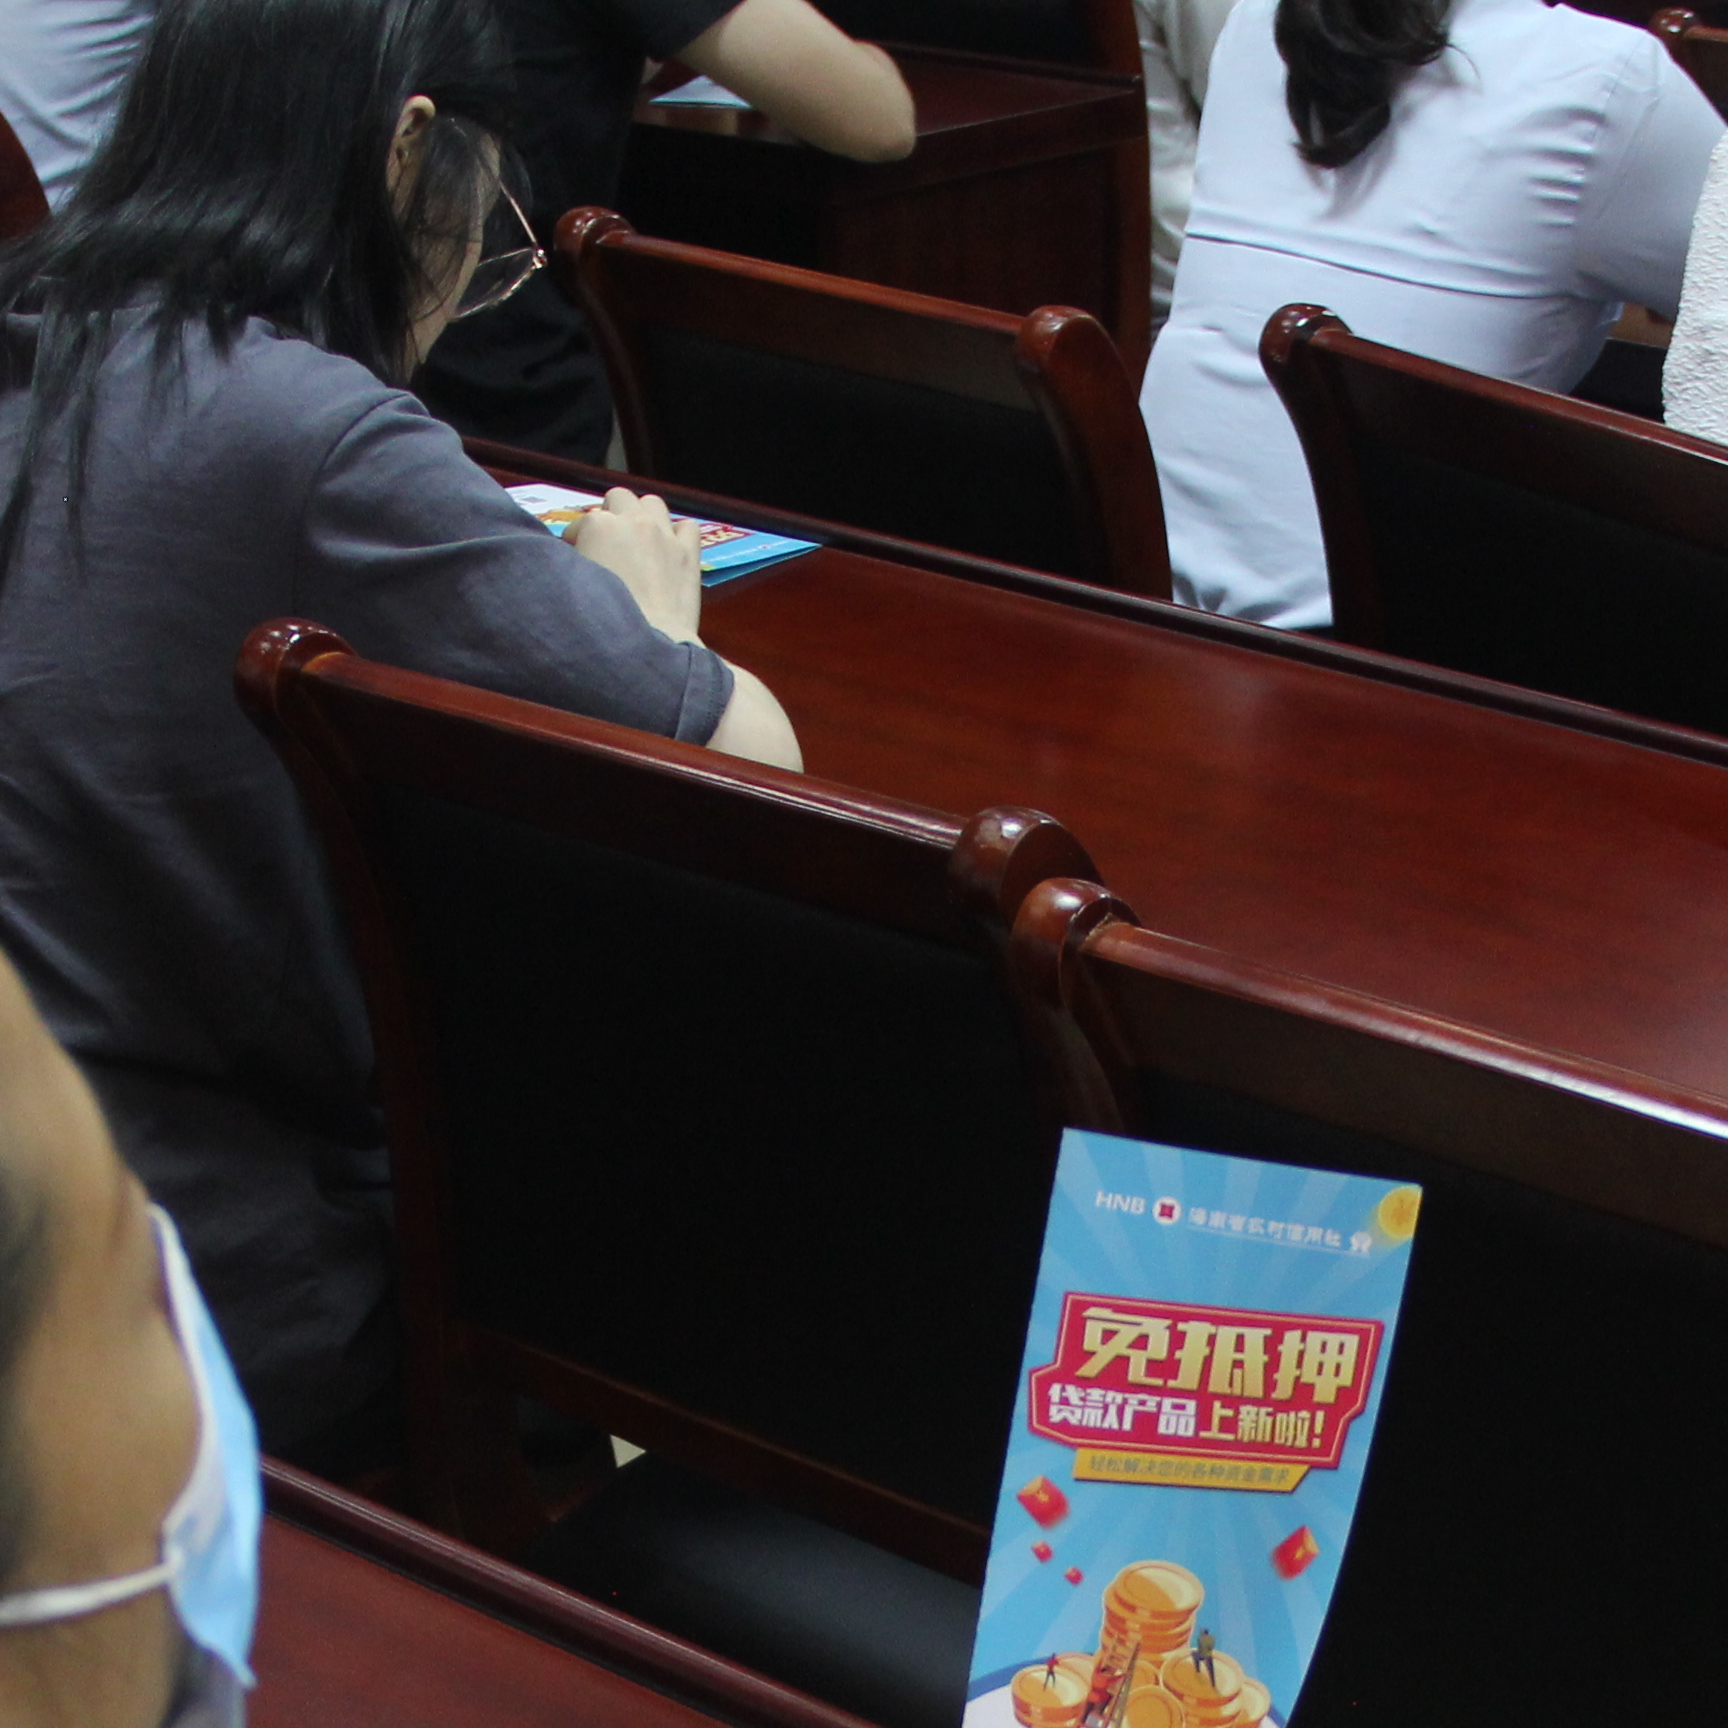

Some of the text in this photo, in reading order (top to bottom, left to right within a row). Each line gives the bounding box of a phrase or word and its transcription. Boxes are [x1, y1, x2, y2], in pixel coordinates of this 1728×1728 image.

[1095, 1191, 1147, 1215] HNB
[1074, 1306, 1361, 1404] 免抵押
